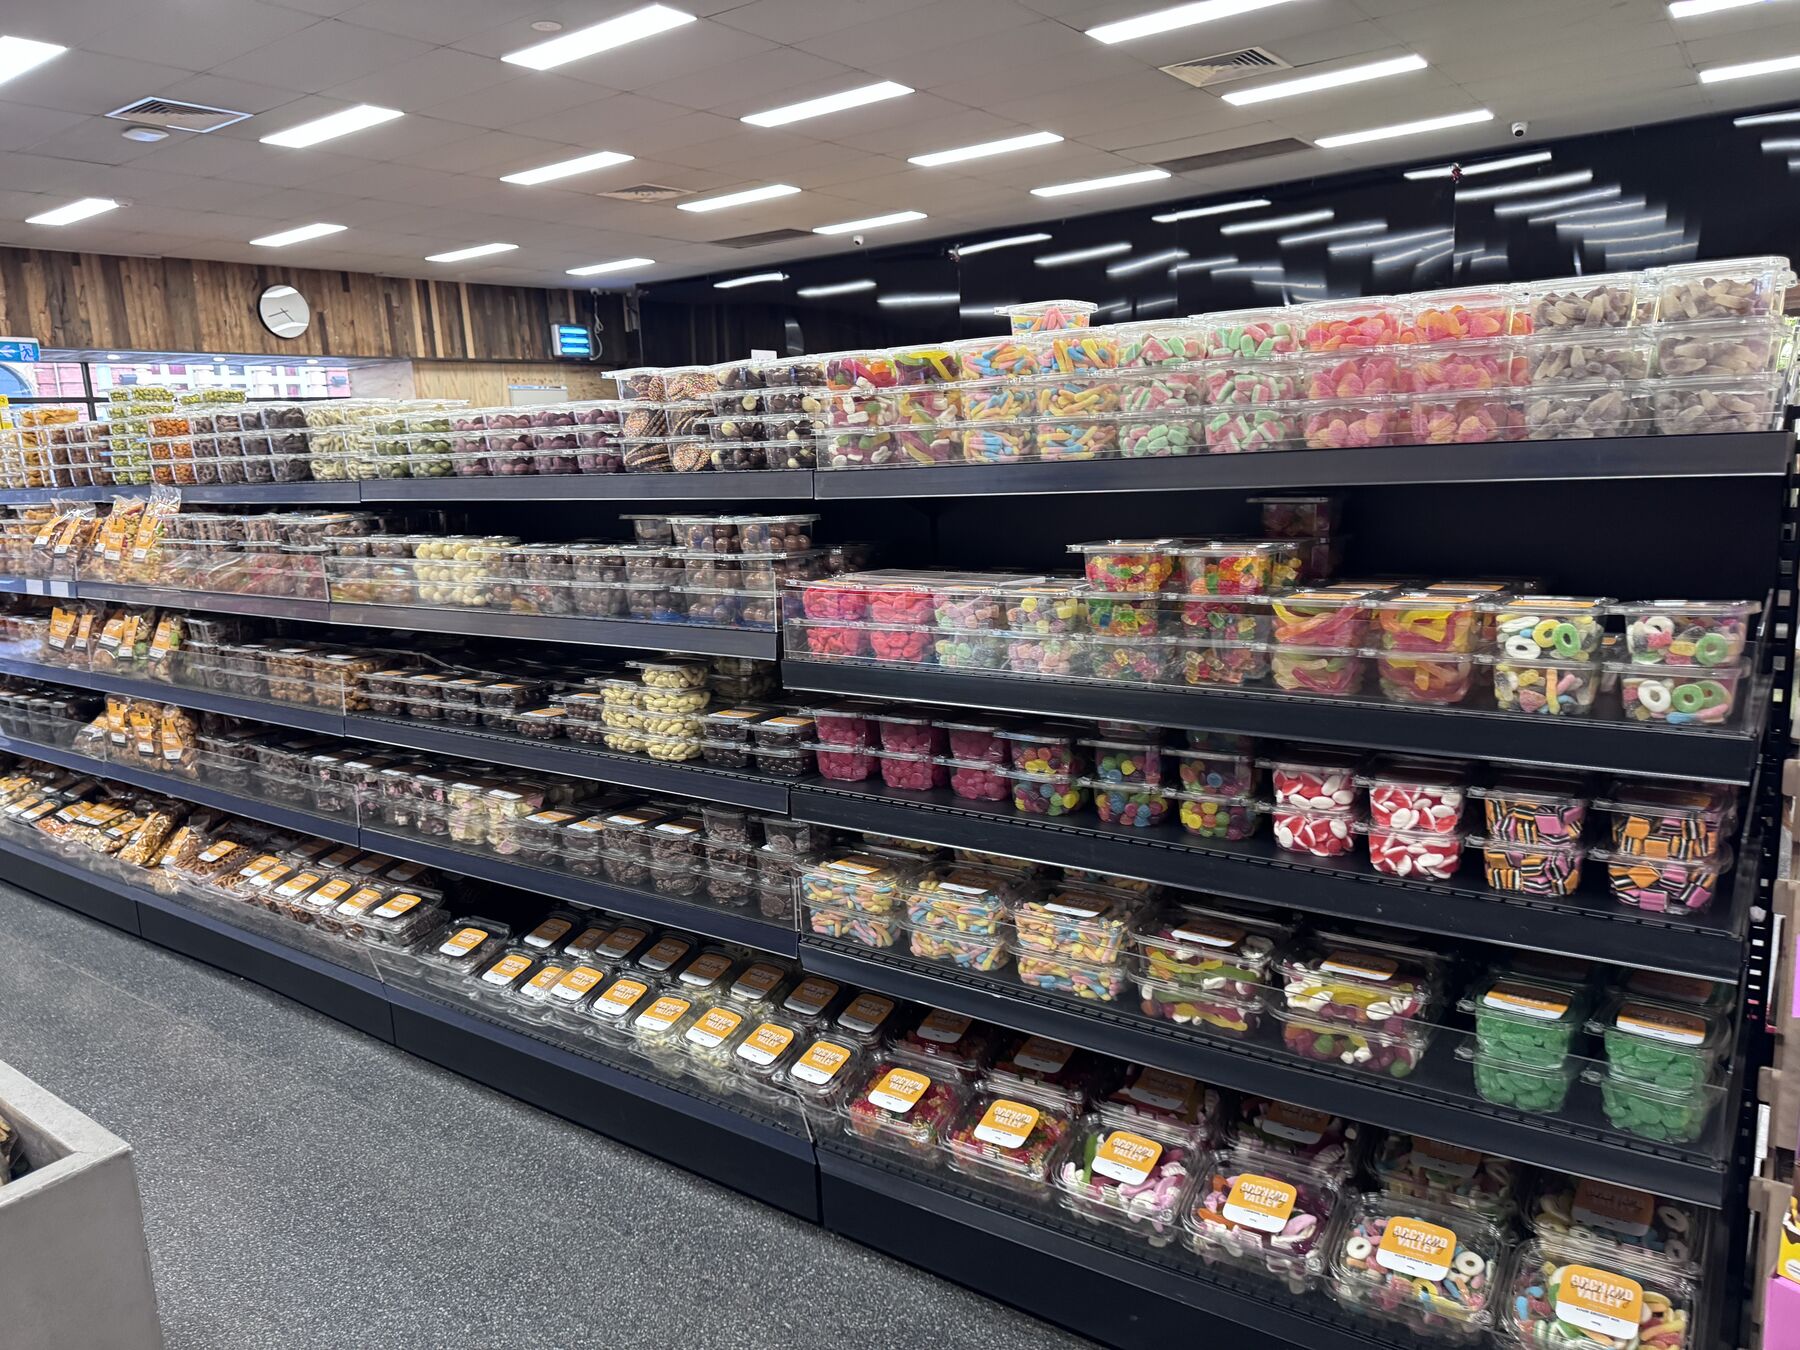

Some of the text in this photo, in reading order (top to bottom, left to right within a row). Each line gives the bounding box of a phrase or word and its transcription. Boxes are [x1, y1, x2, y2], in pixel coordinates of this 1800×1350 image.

[994, 1115, 1024, 1128] VALLEY
[1113, 1146, 1145, 1163] VALLEY
[1240, 1182, 1289, 1203] ORCHARD
[1243, 1192, 1280, 1208] VALLEY
[1392, 1225, 1448, 1248] ORCHARD
[1397, 1237, 1437, 1254] VALLEY
[1570, 1274, 1632, 1302] ORCHARD
[1577, 1288, 1622, 1308] VALLEY
